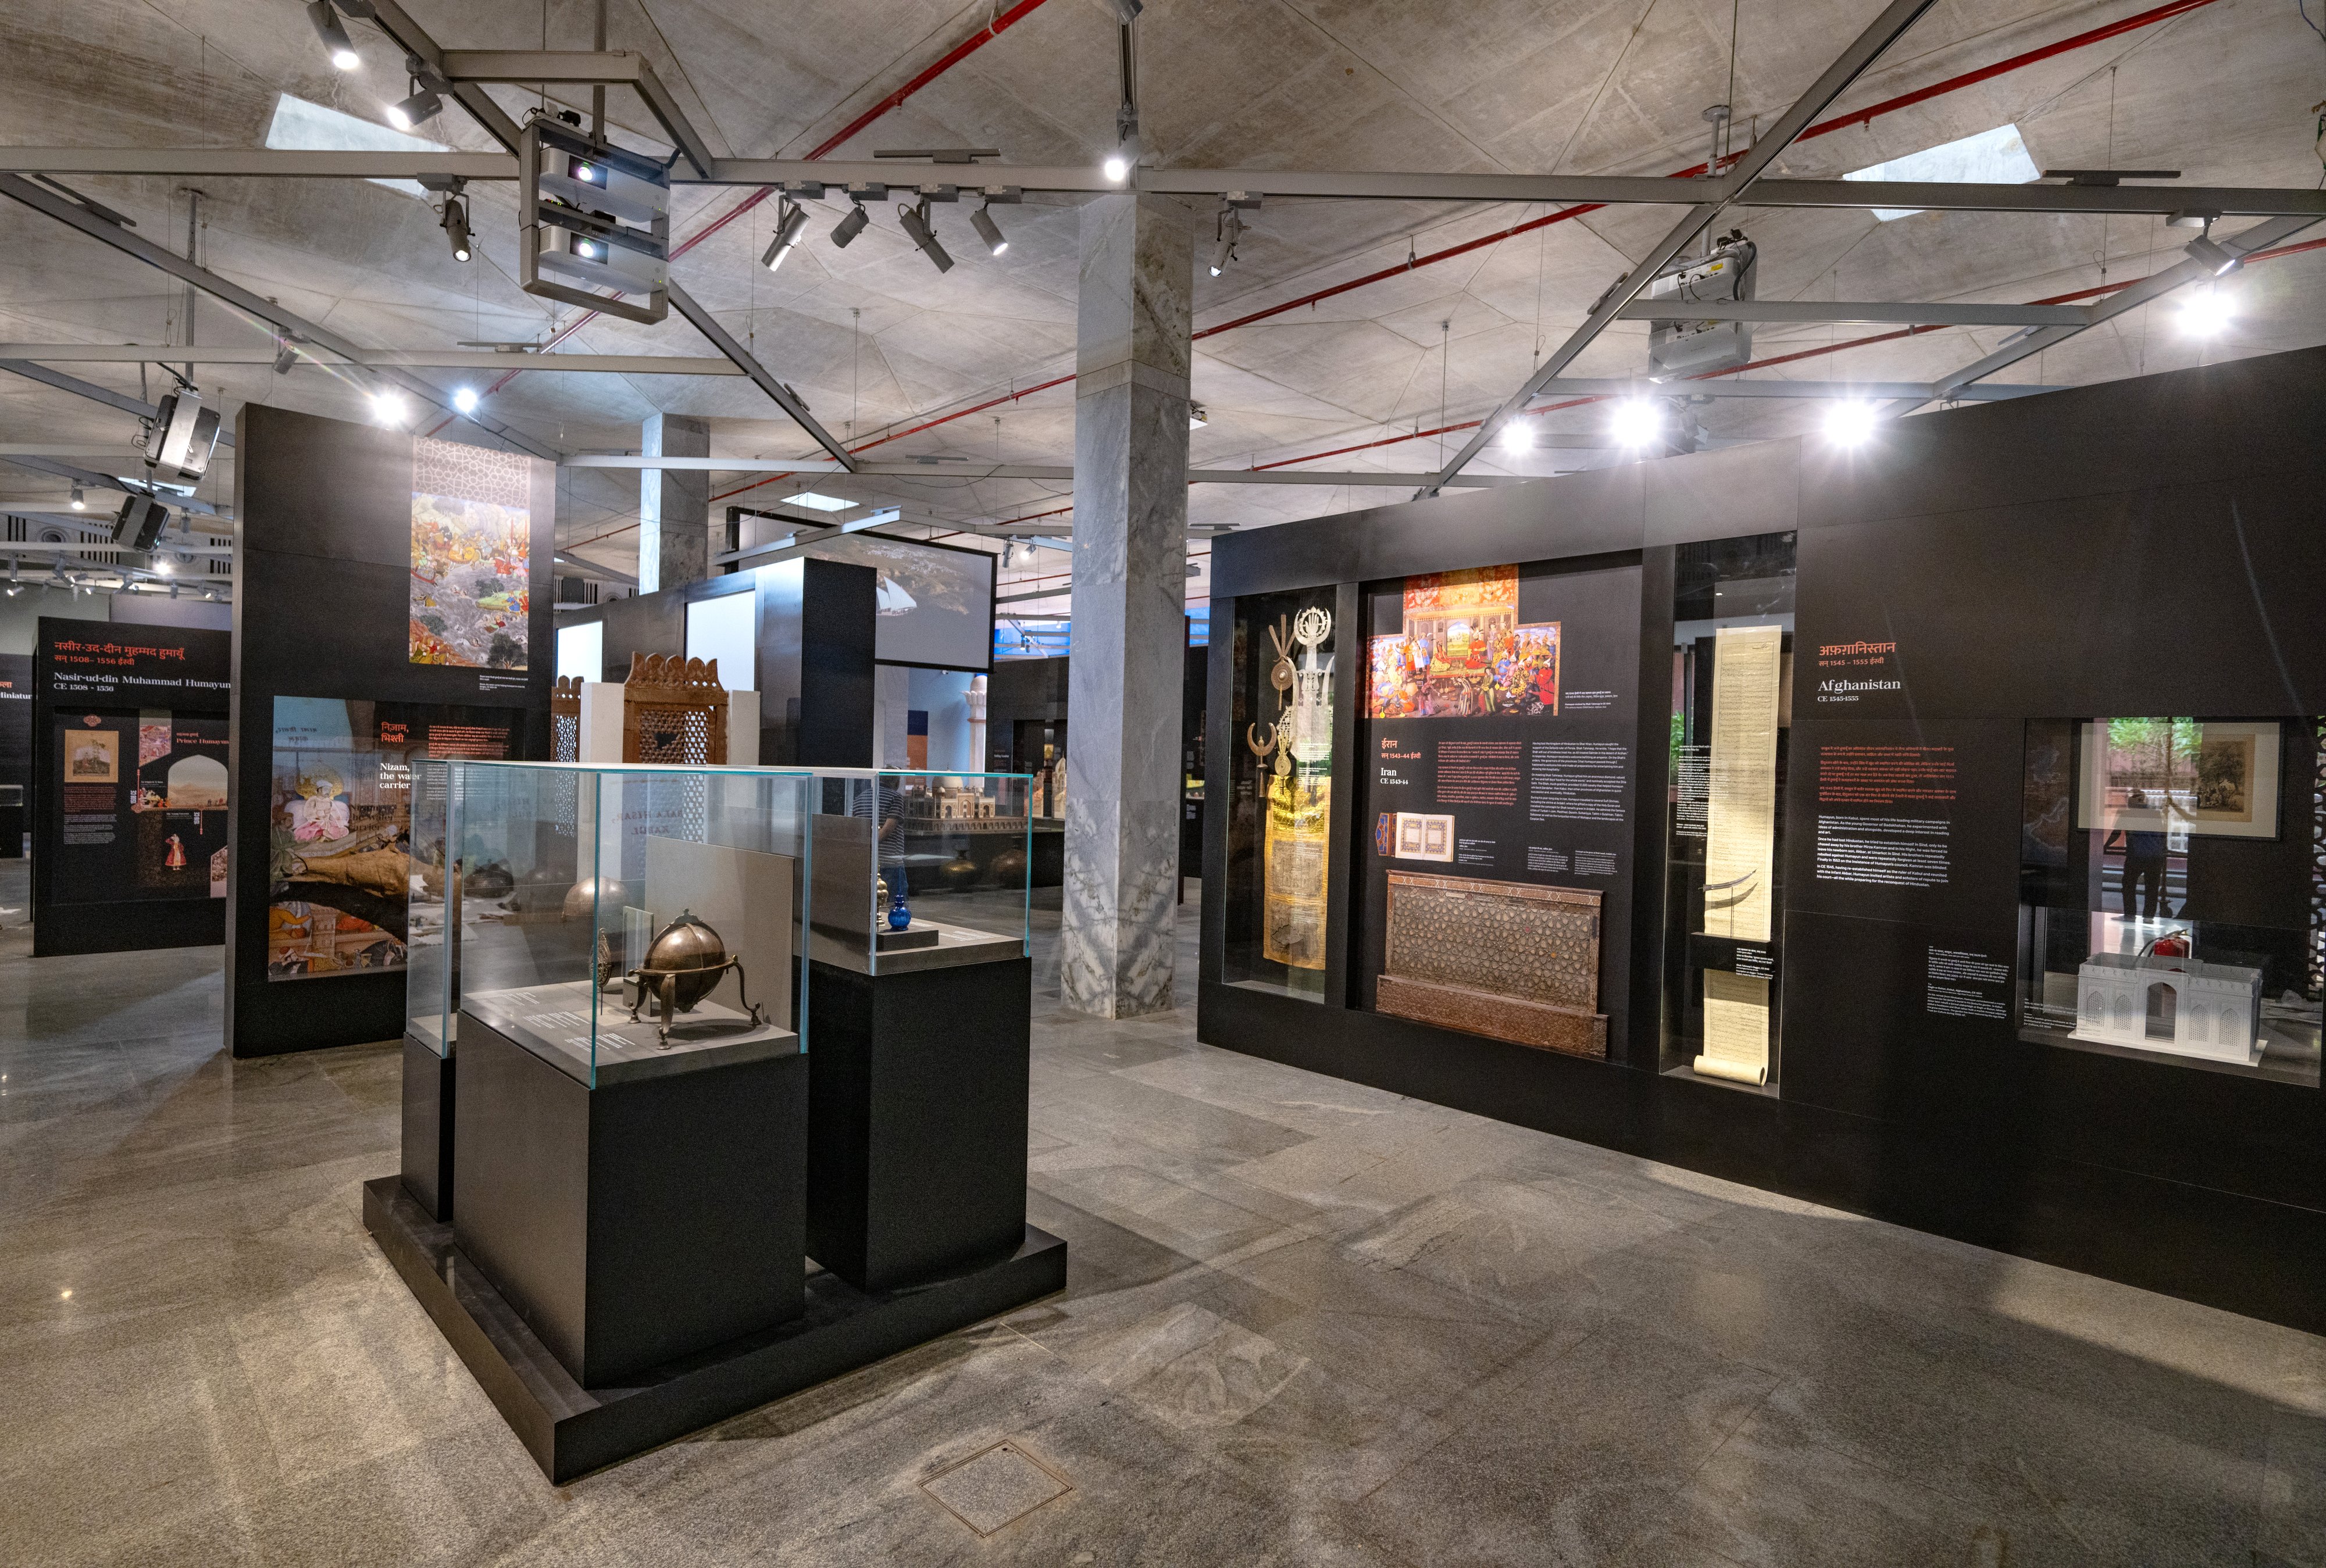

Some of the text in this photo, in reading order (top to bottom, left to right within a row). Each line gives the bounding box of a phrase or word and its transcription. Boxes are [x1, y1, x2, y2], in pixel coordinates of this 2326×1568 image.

[124, 646, 157, 657] मुहम्मद
[159, 647, 185, 660] हुमायूँ
[117, 656, 135, 665] ईस्वी
[1870, 657, 1884, 665] ईस्वी
[53, 672, 231, 690] Nasir-ud-din Muhammad Humayun
[1818, 679, 1902, 694] Afghanistan
[1381, 737, 1398, 750] ईरान
[1410, 751, 1421, 760] ईस्वी
[380, 763, 410, 773] Nizam,
[1380, 767, 1397, 776] Iran
[379, 772, 395, 780] the
[379, 781, 411, 789] carrier
